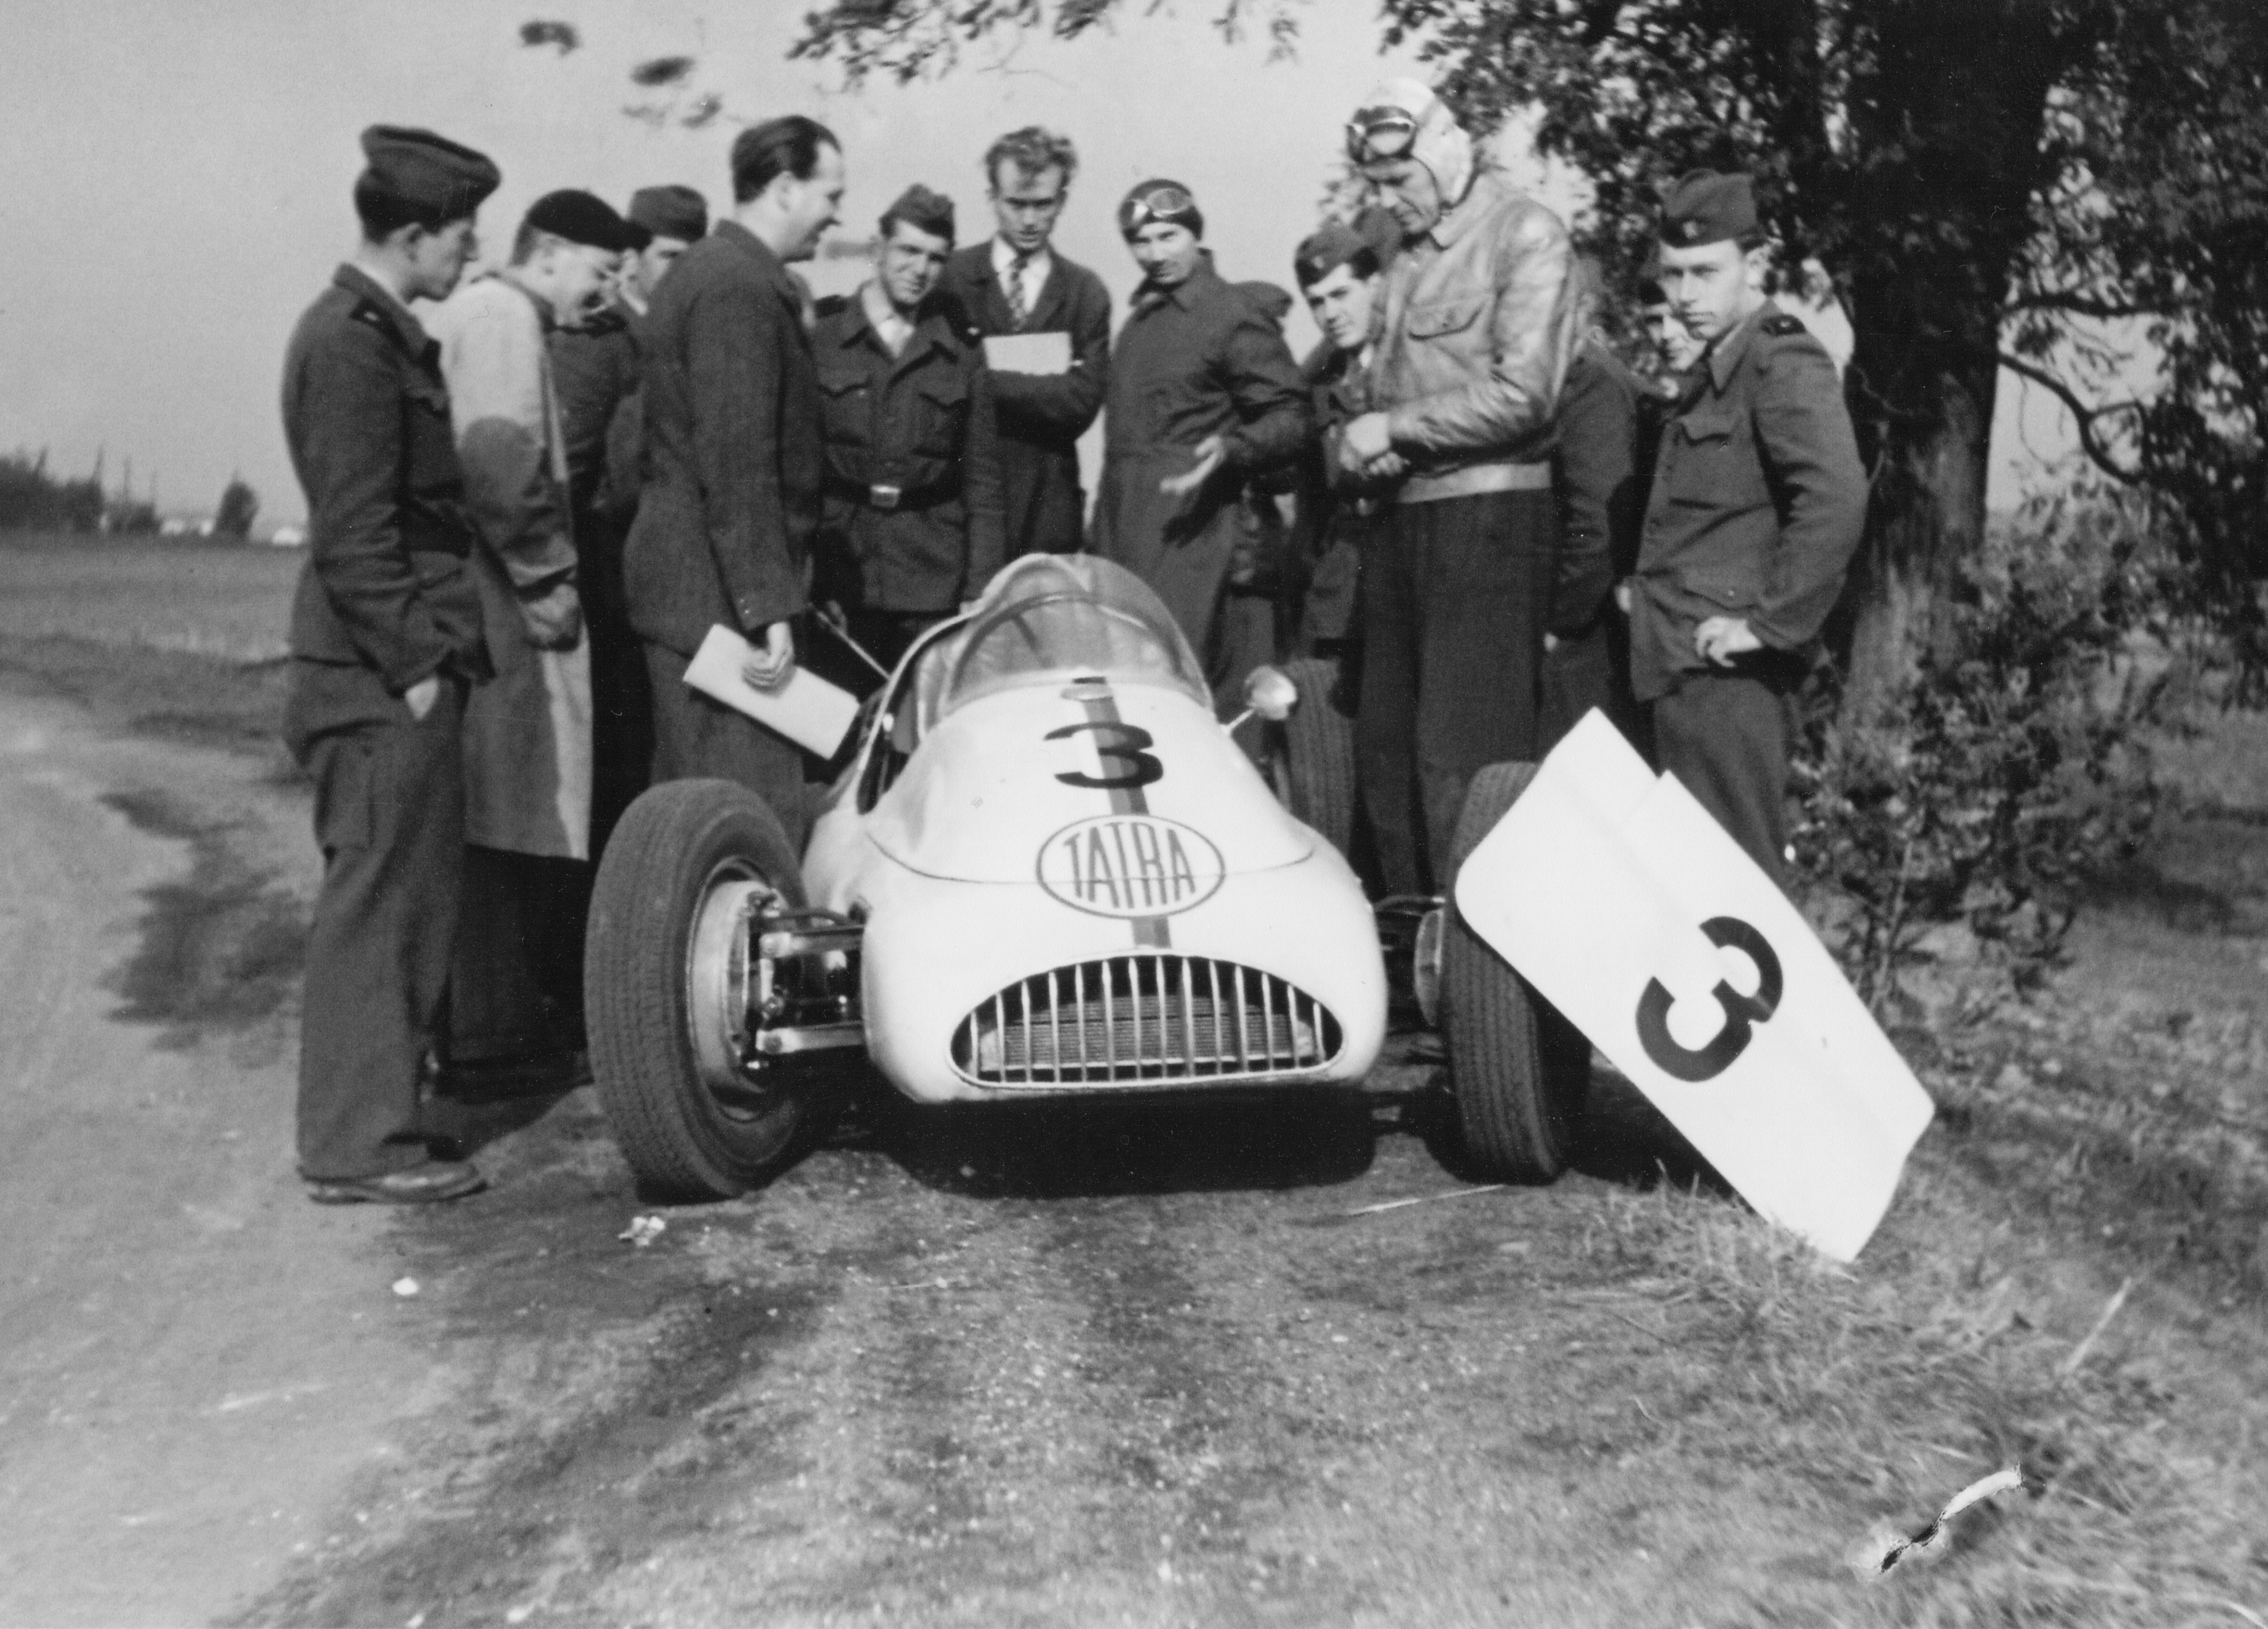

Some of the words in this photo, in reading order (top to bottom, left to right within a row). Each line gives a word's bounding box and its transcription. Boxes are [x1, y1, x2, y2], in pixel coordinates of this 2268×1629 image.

[1043, 721, 1164, 789] 3
[1063, 821, 1196, 909] TATRA
[1635, 916, 1783, 1083] 3
